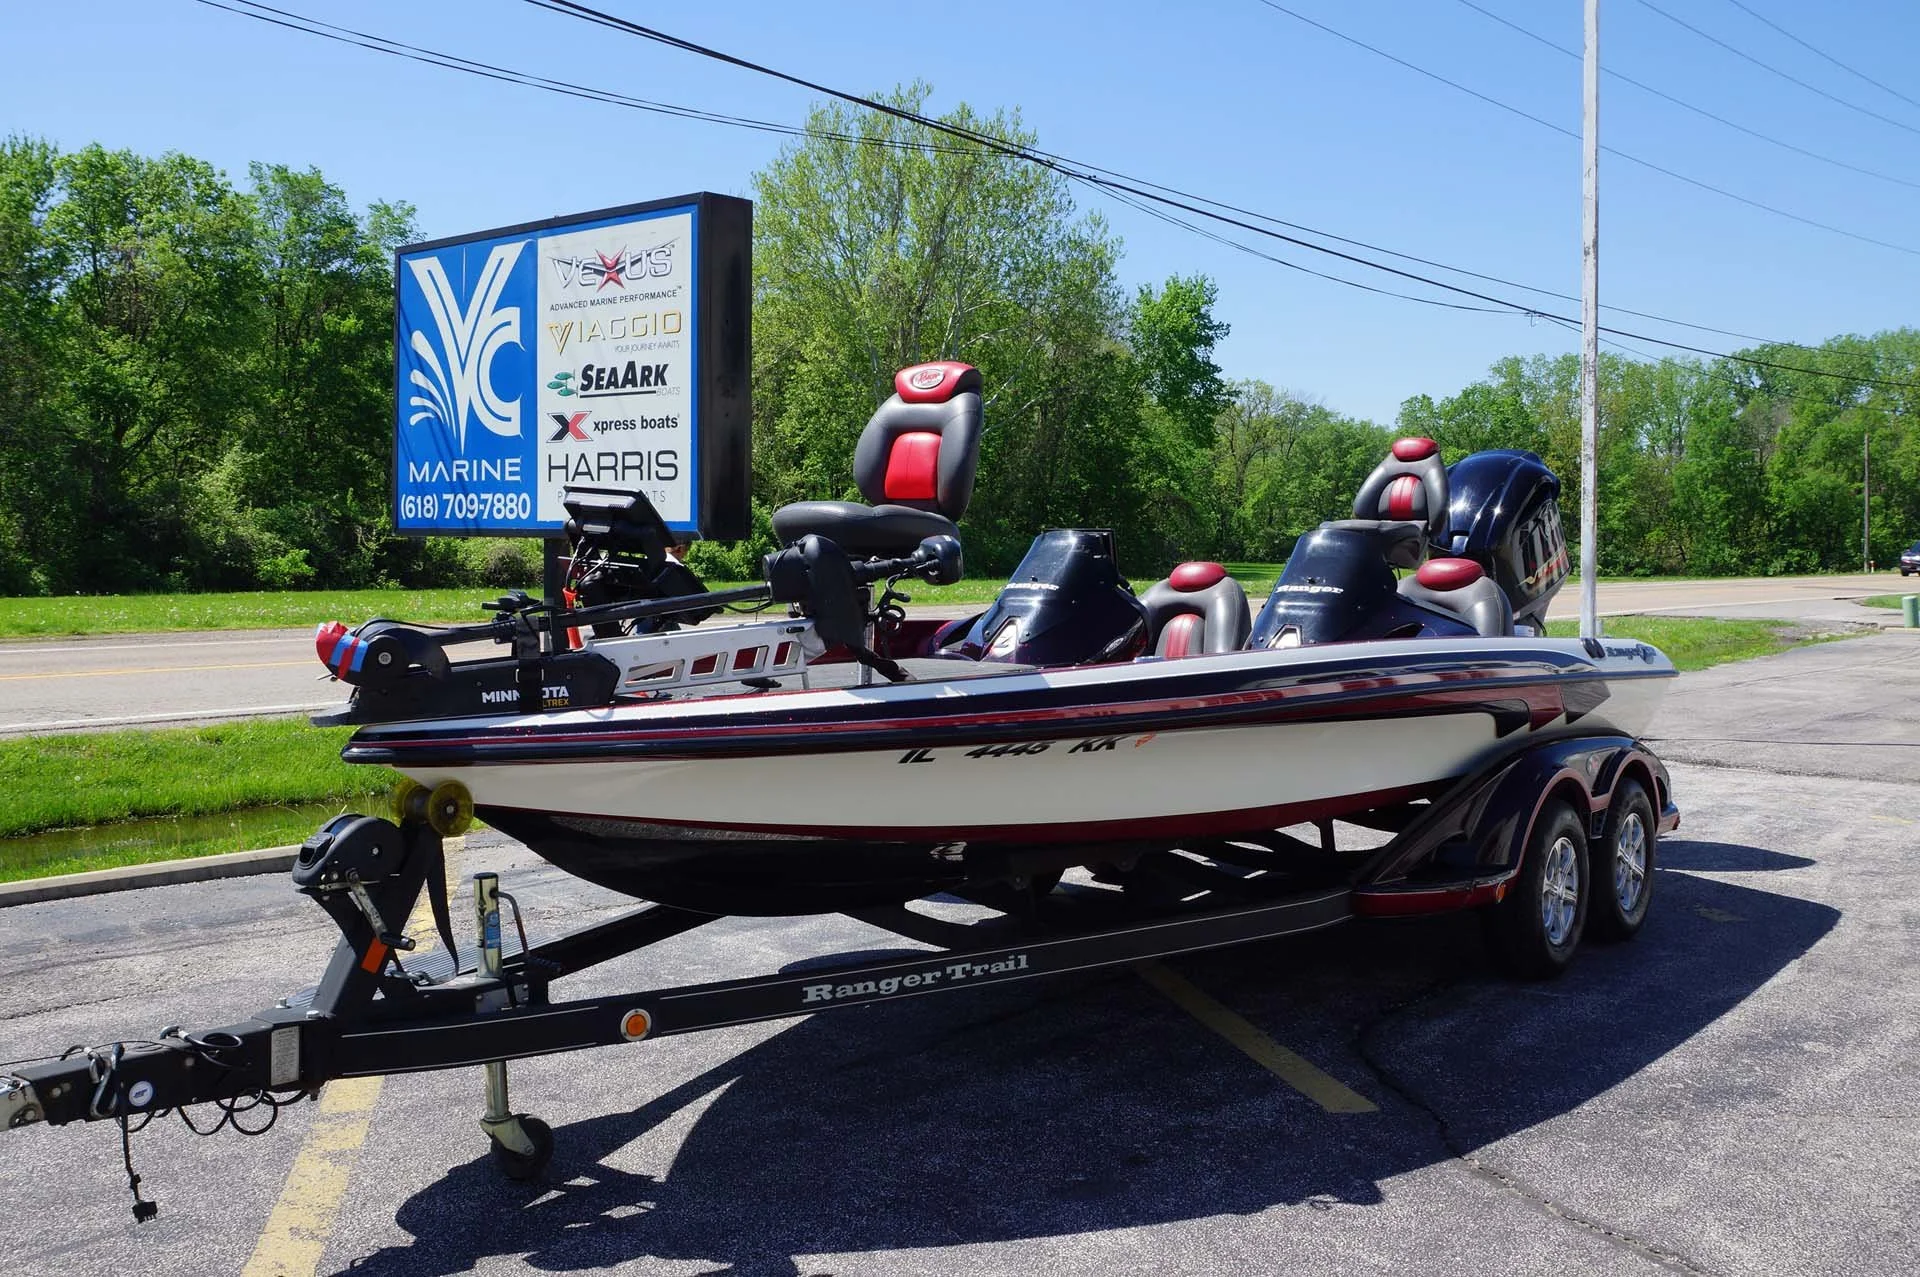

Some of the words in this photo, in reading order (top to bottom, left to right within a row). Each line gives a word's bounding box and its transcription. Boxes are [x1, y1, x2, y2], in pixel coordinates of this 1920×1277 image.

[549, 243, 674, 292] VEXUS
[549, 301, 588, 312] ADVANCED
[590, 296, 617, 307] MARINE
[619, 289, 677, 303] PERFORMANCE
[547, 311, 682, 355] VIAGGIO
[656, 386, 680, 397] BOATS
[594, 418, 637, 435] xpress
[641, 415, 678, 430] boats
[409, 457, 521, 482] MARINE
[548, 450, 678, 482] HARRIS
[401, 493, 439, 520] (618)
[442, 492, 531, 520] 709-7880
[541, 685, 569, 698] OTA
[898, 748, 936, 764] IL
[802, 971, 942, 1003] Ranger
[946, 954, 1029, 980] Trail
